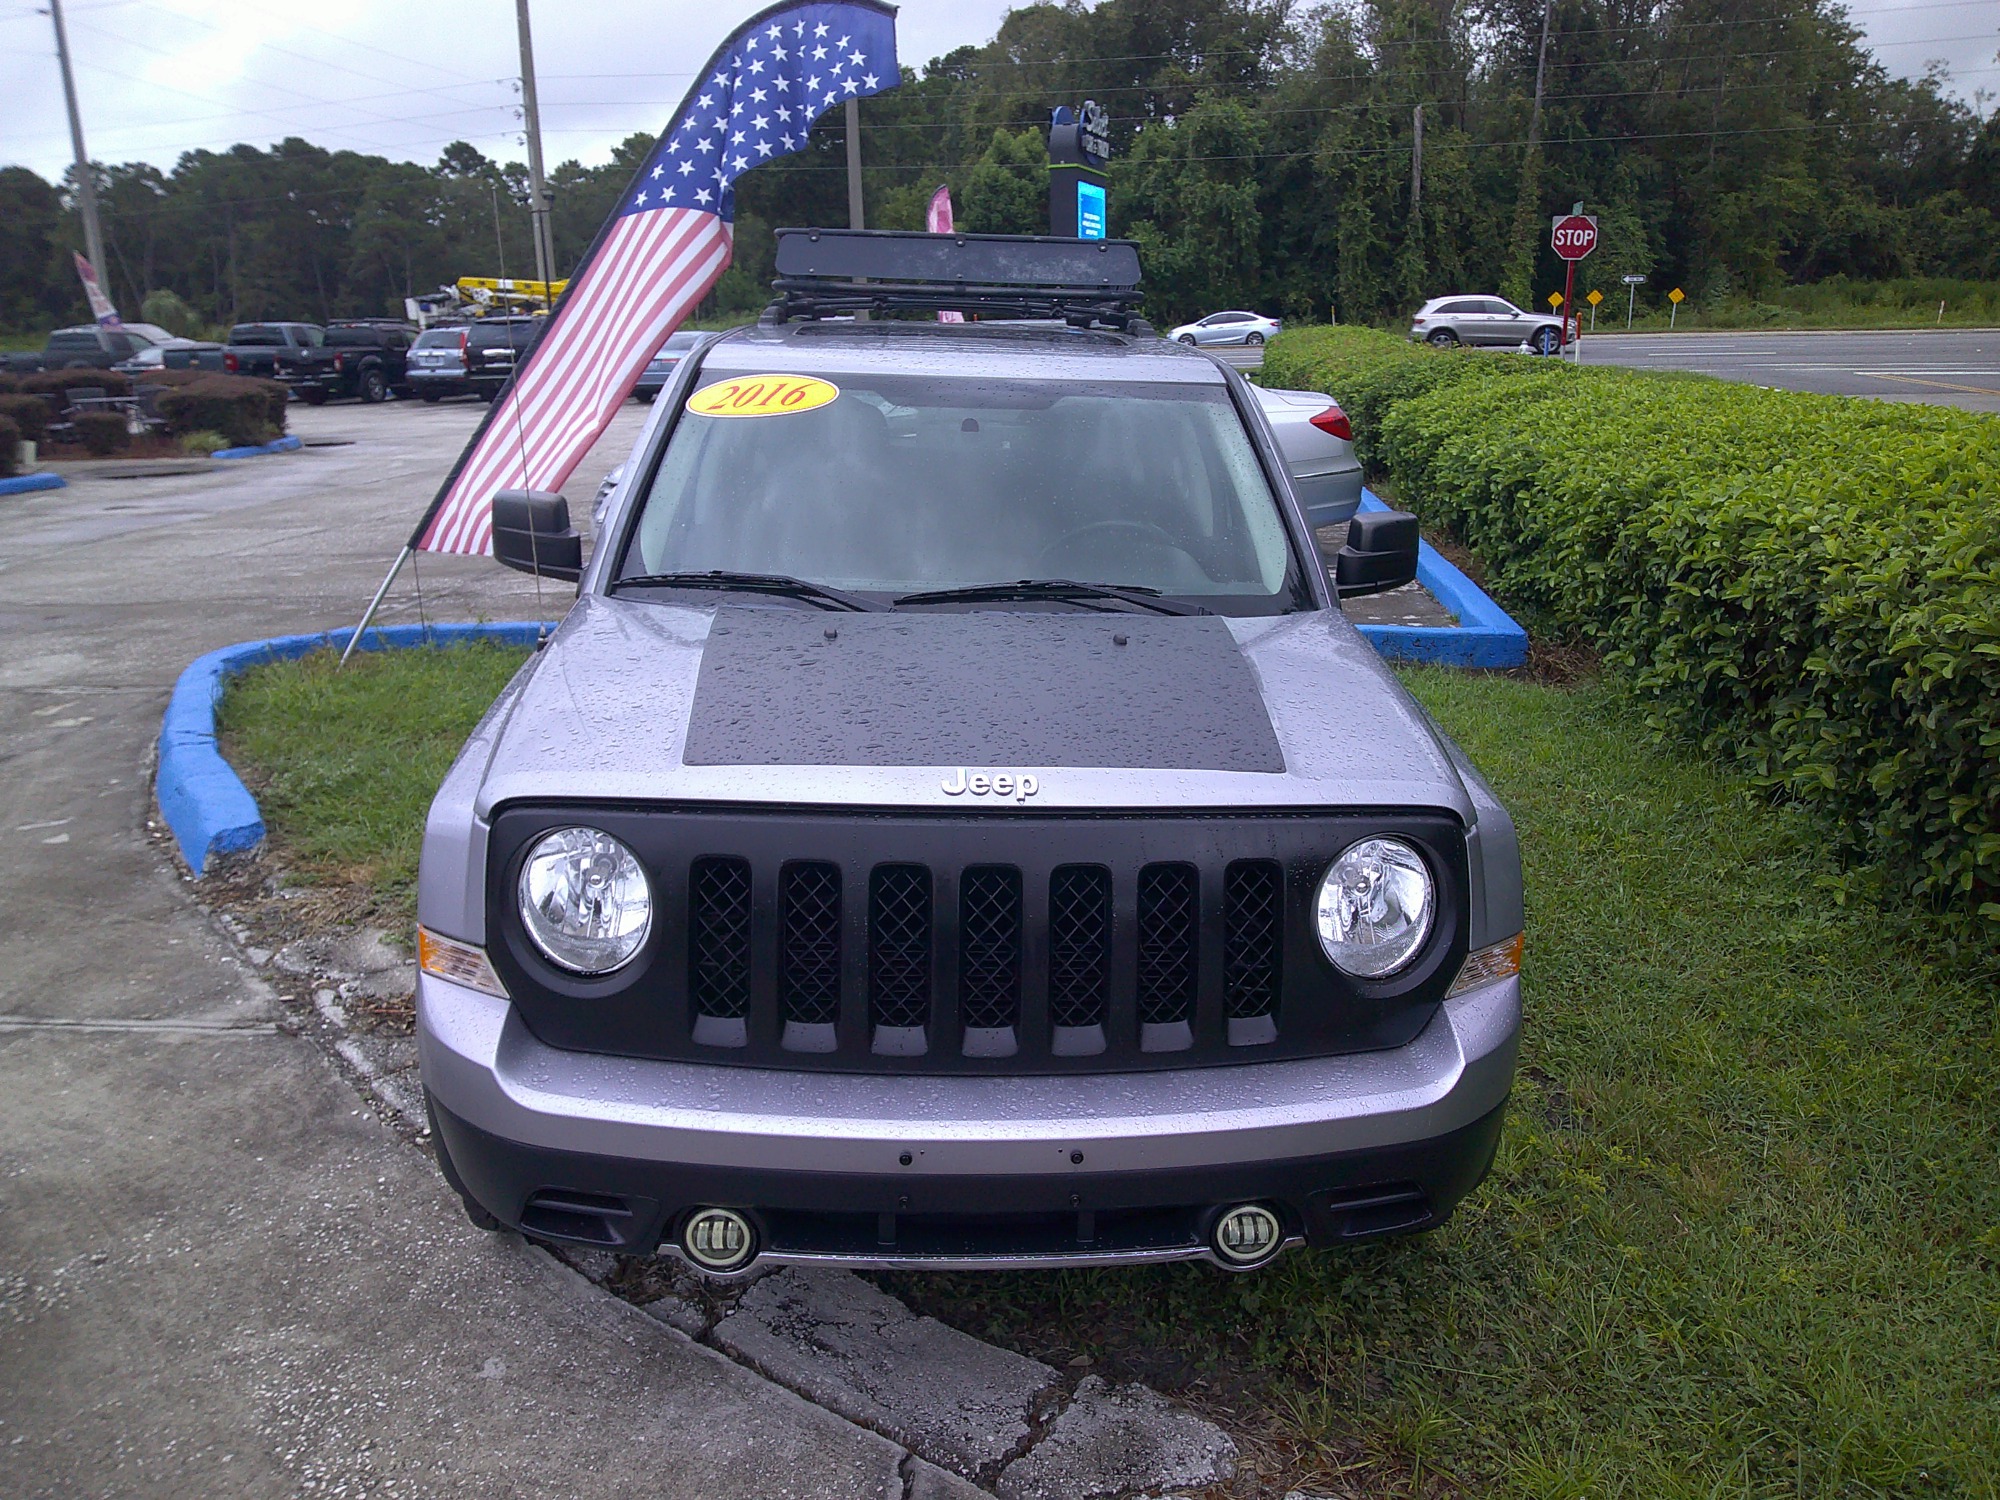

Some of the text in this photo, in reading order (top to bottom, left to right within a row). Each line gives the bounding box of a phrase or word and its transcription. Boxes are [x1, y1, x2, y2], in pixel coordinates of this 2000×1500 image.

[1555, 230, 1594, 246] STOP
[706, 383, 817, 410] 2016
[941, 768, 1039, 802] Jeep
